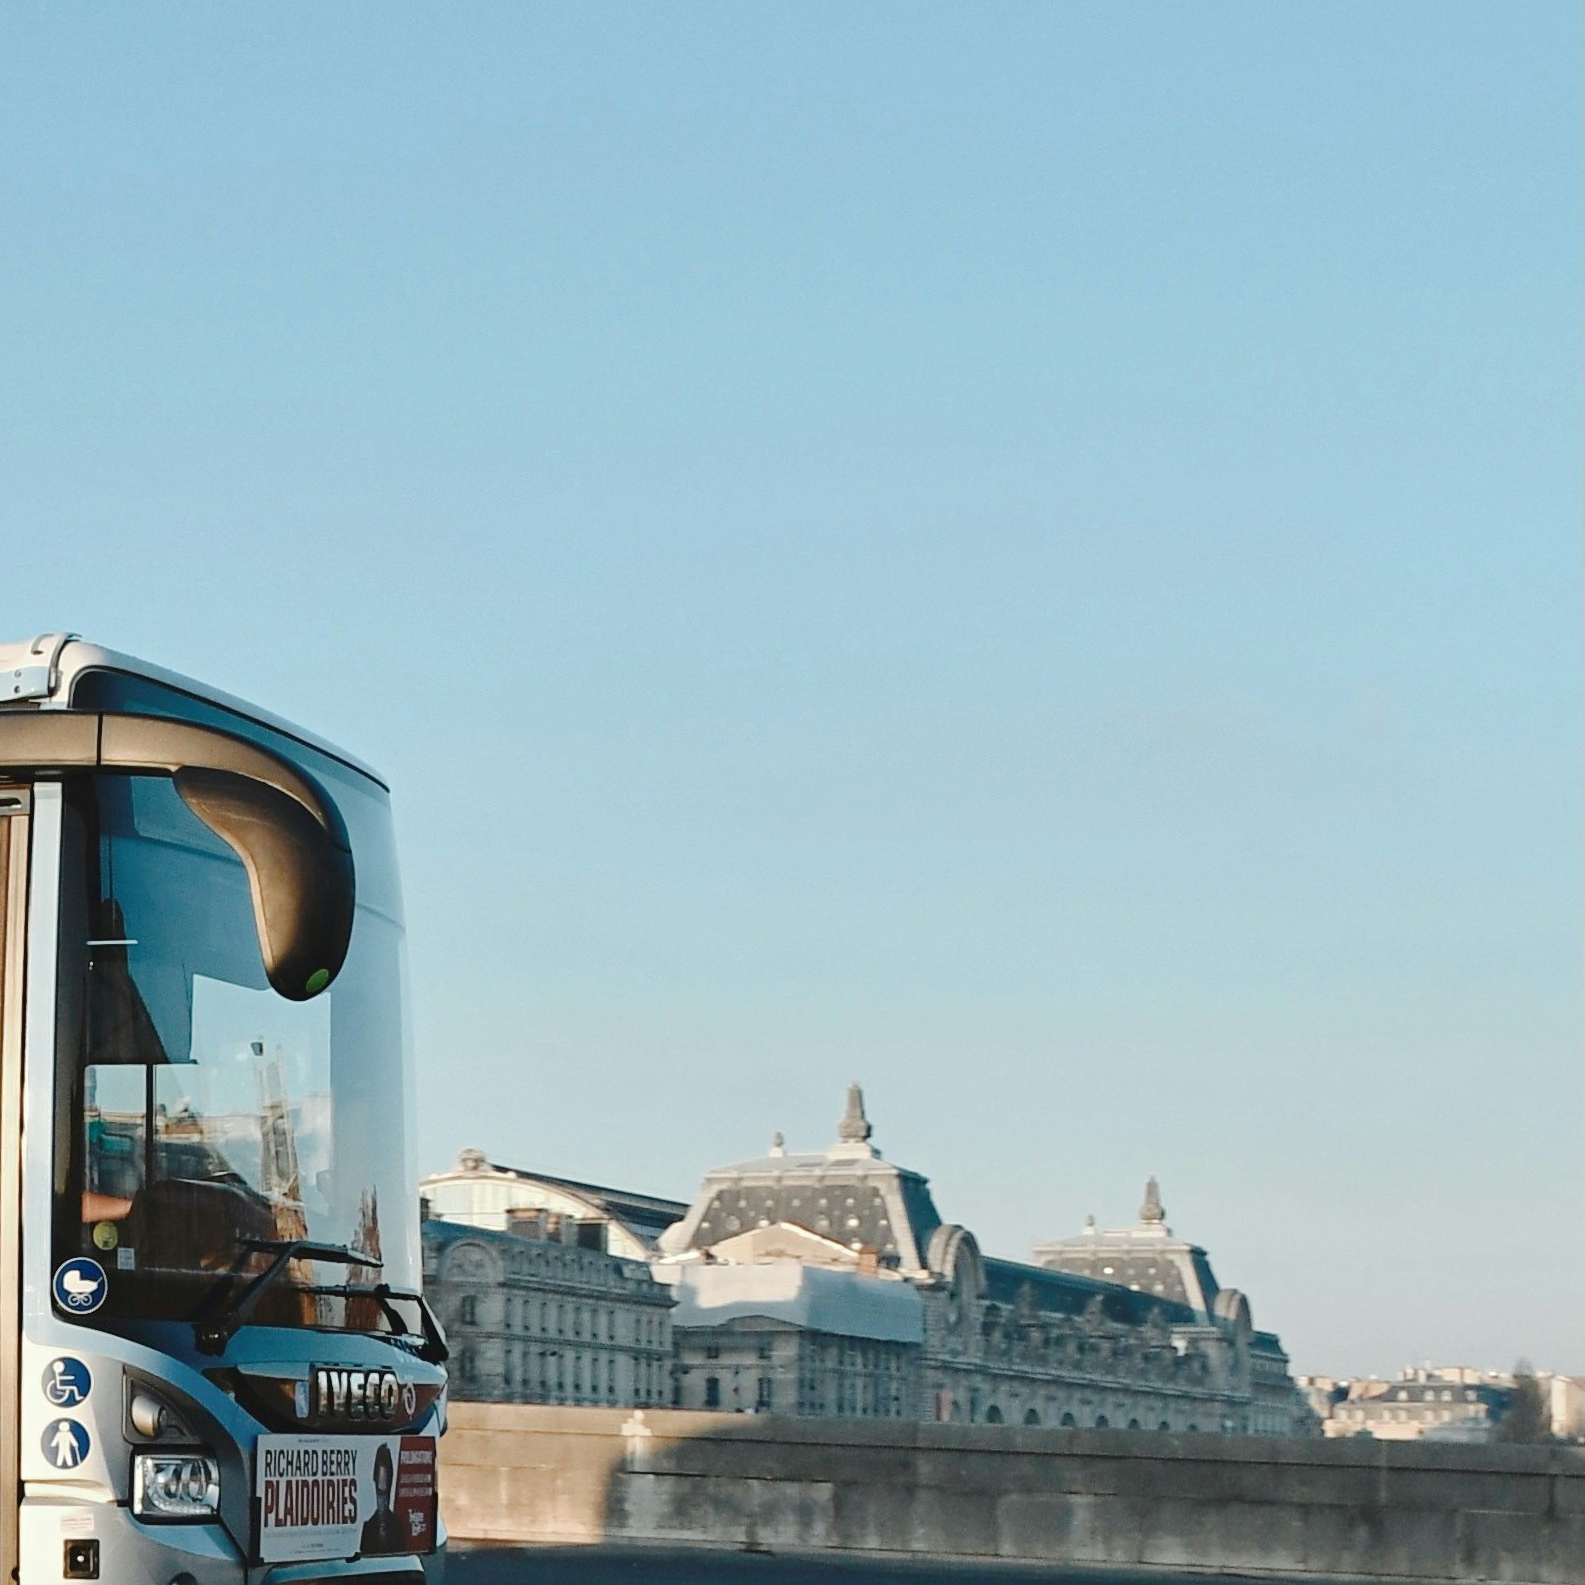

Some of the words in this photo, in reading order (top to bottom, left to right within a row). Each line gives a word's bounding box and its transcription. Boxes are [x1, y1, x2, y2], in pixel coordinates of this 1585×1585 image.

[317, 1370, 399, 1419] IVECO
[264, 1449, 319, 1478] RICHARD
[321, 1449, 358, 1477] BERRY
[263, 1478, 358, 1528] PLAIDOIRIES
